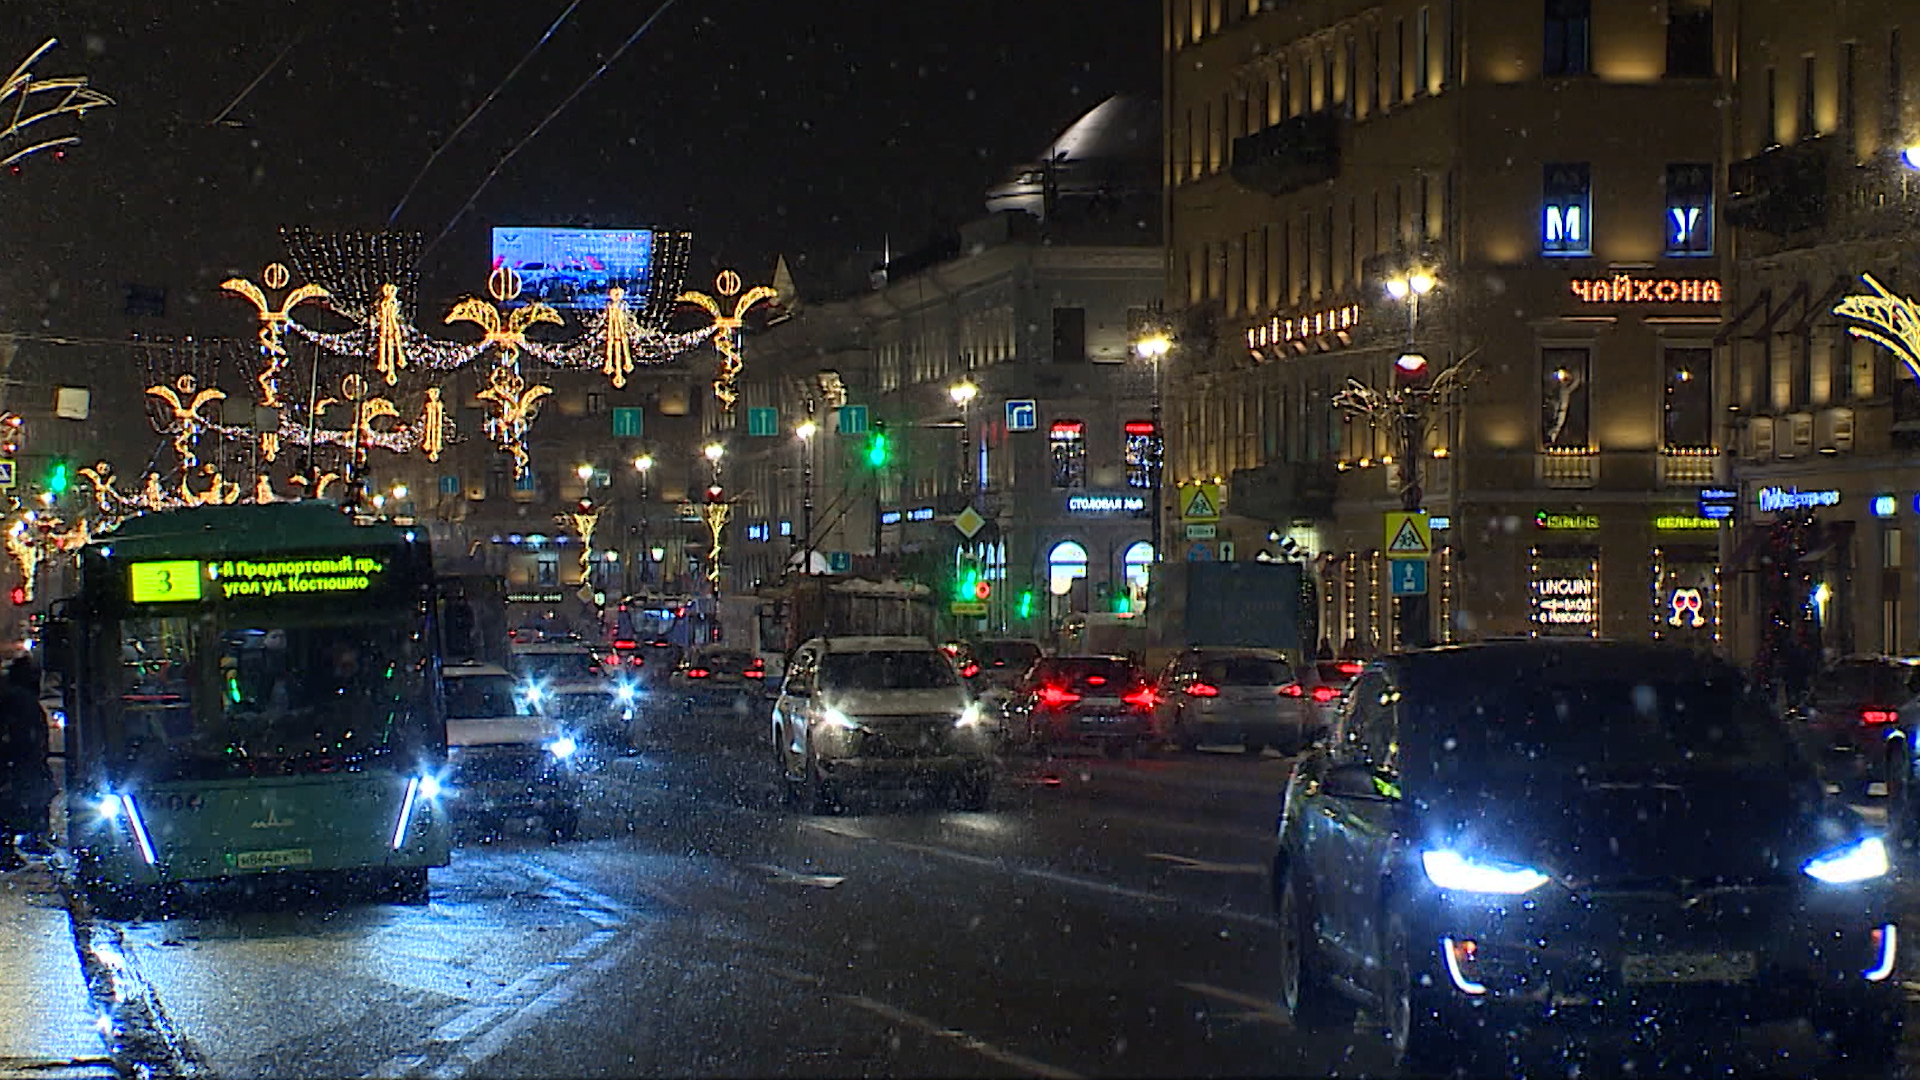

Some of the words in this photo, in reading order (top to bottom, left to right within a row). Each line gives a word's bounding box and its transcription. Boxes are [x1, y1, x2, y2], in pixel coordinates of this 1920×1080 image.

[1547, 206, 1581, 241] М
[1571, 274, 1721, 302] ЧАЙХОНА
[1068, 498, 1123, 511] СТОЛОВАЯ
[237, 556, 351, 578] Предпортовый
[156, 570, 172, 594] 3
[222, 580, 260, 598] угол
[263, 578, 286, 596] ул.
[289, 576, 369, 592] Костюшко
